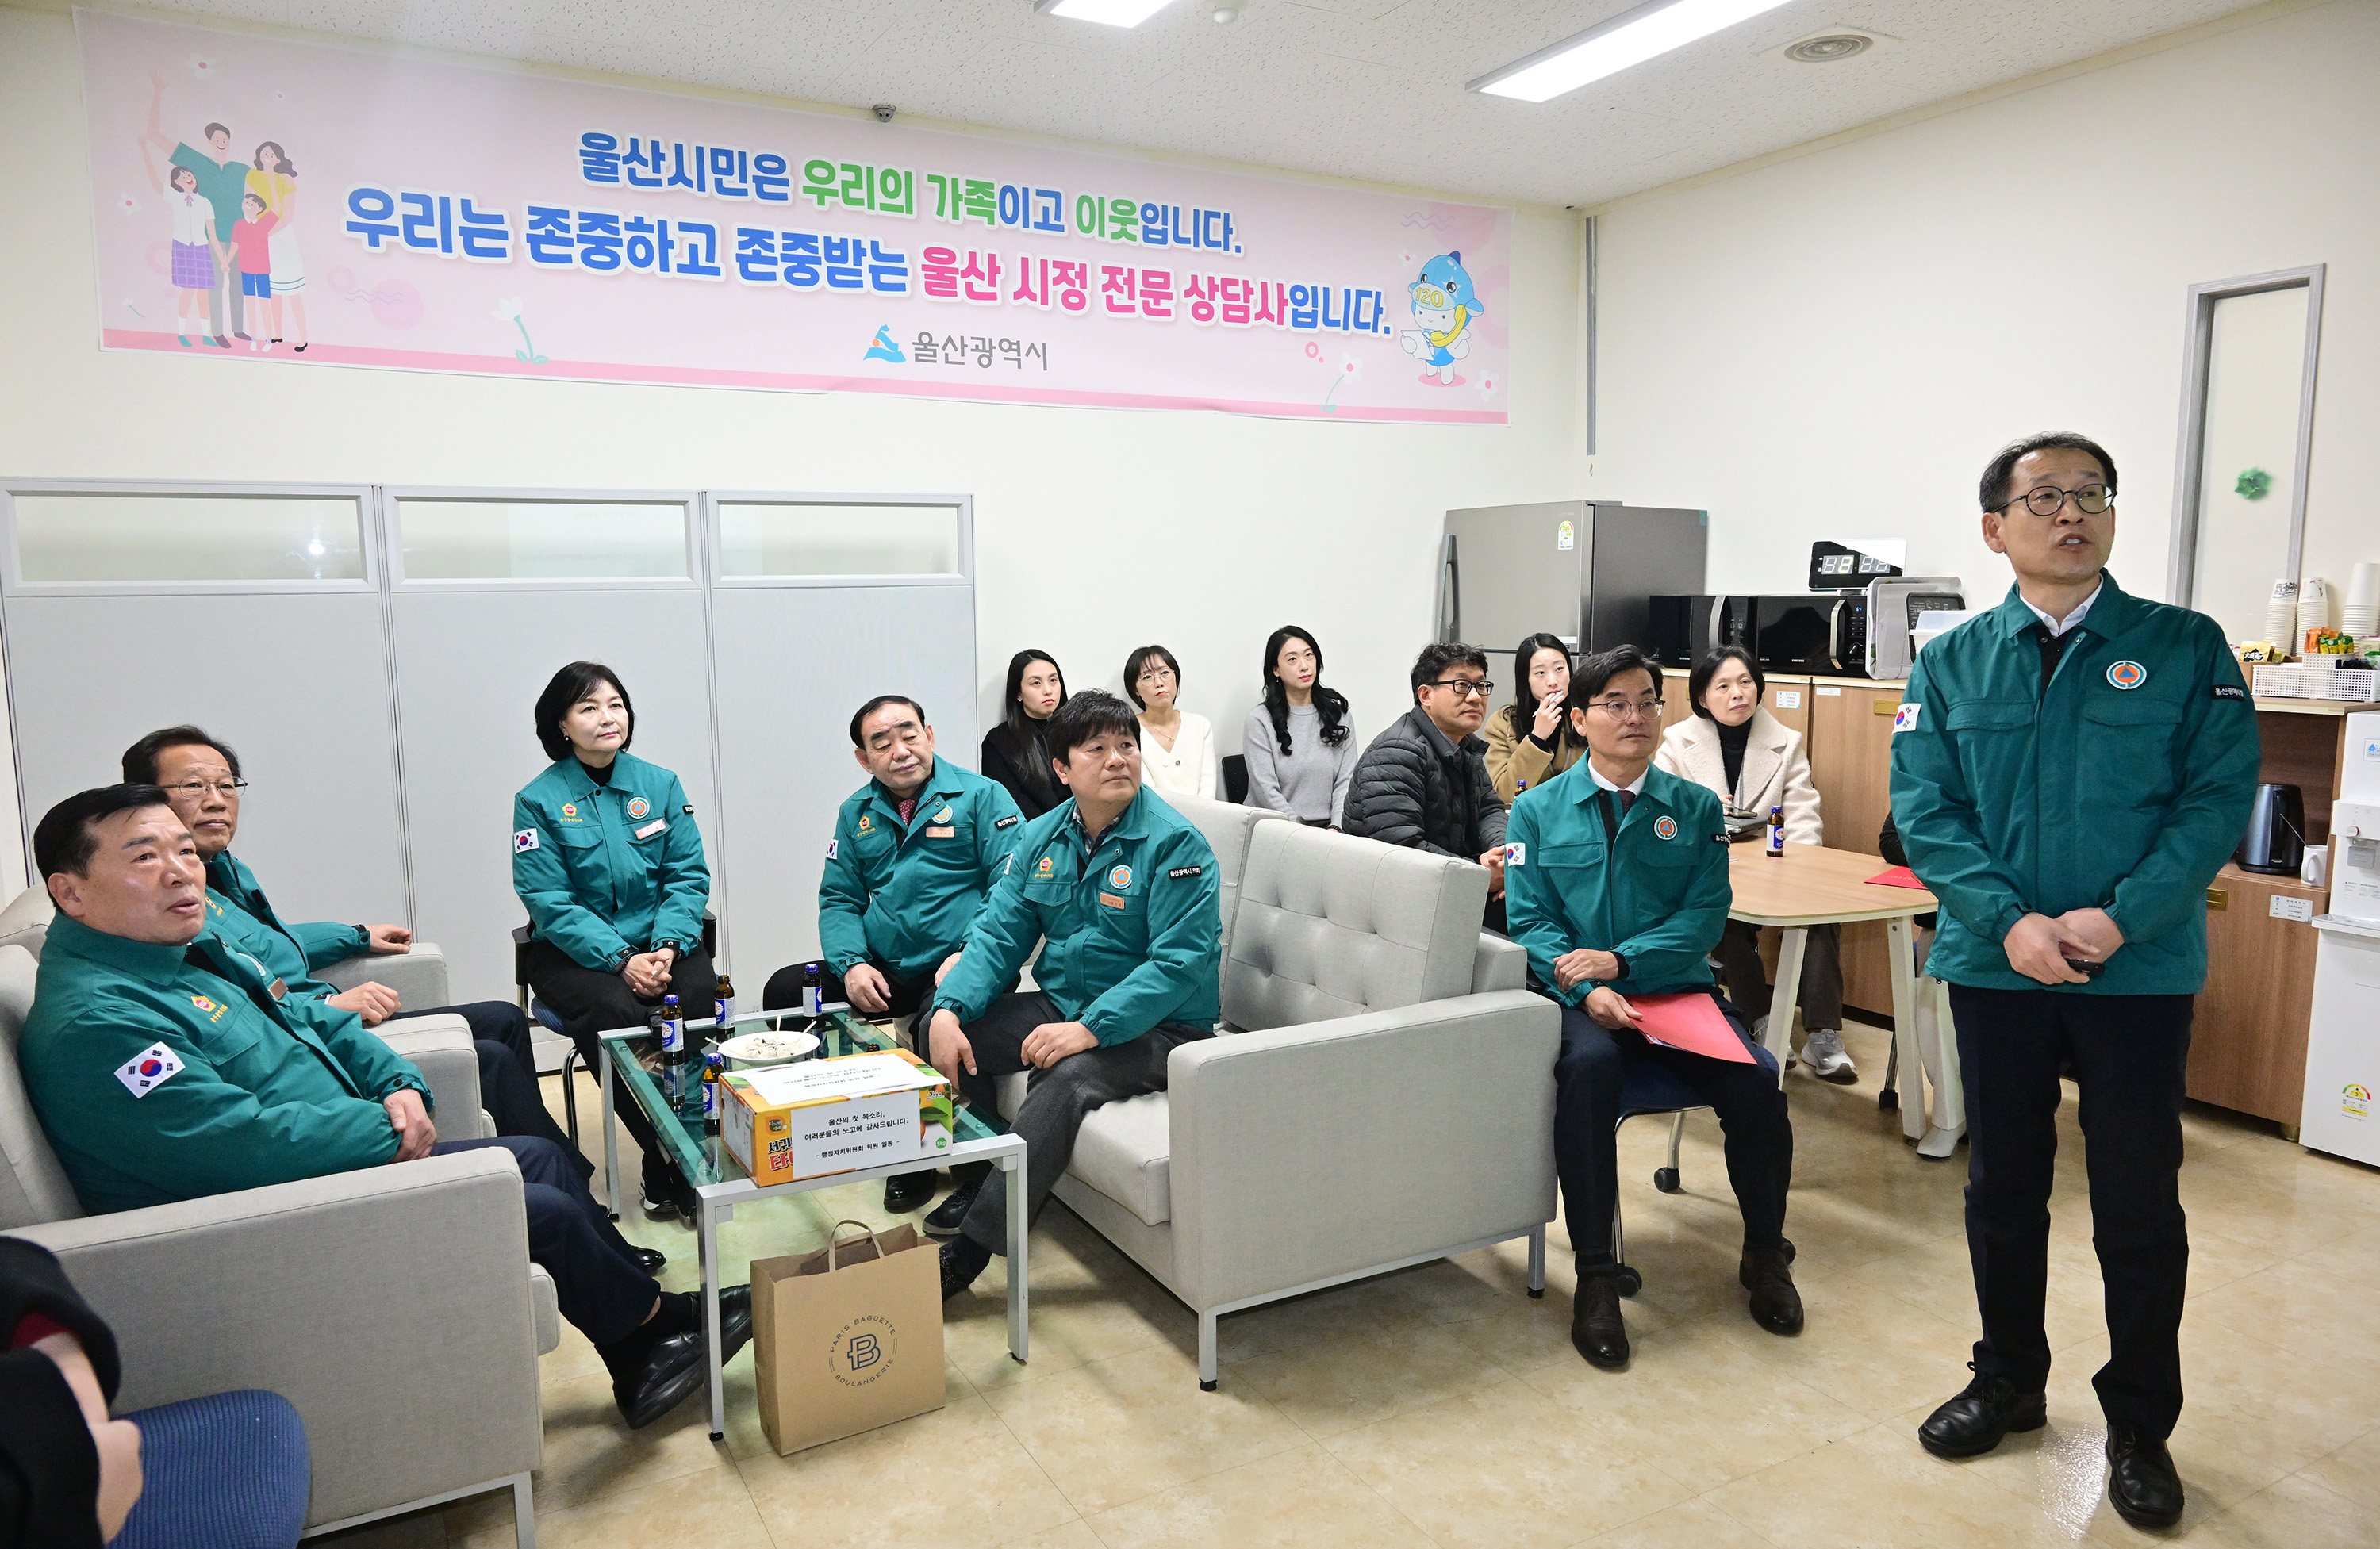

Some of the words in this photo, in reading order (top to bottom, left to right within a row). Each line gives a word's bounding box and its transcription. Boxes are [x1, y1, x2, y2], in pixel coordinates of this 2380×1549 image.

[578, 132, 790, 202] 울산시민은
[801, 159, 913, 216] 우리의
[927, 173, 1065, 233] 가족이고
[1076, 194, 1242, 255] 이웃입니다.
[345, 187, 509, 259] 우리는
[524, 205, 721, 278] 존중하고
[735, 226, 908, 293] 존중받는
[921, 246, 1002, 301] 울산
[1012, 256, 1088, 311] 시정
[1101, 264, 1174, 316] 전문
[1184, 273, 1392, 335] 상담사입니다.
[1415, 287, 1444, 308] 120
[912, 330, 1049, 371] 울산광역시
[804, 1129, 839, 1141] 여러분들의
[843, 1125, 863, 1134] 노고에
[866, 1118, 908, 1131] 감사드립니다.
[828, 1117, 849, 1126] 울산의
[768, 1137, 793, 1153] 서귀
[822, 1145, 864, 1159] 행정자치위원회
[830, 1325, 850, 1352] PARIS
[854, 1315, 896, 1336] BAGUETTE
[835, 1359, 893, 1386] BOULANGERIE
